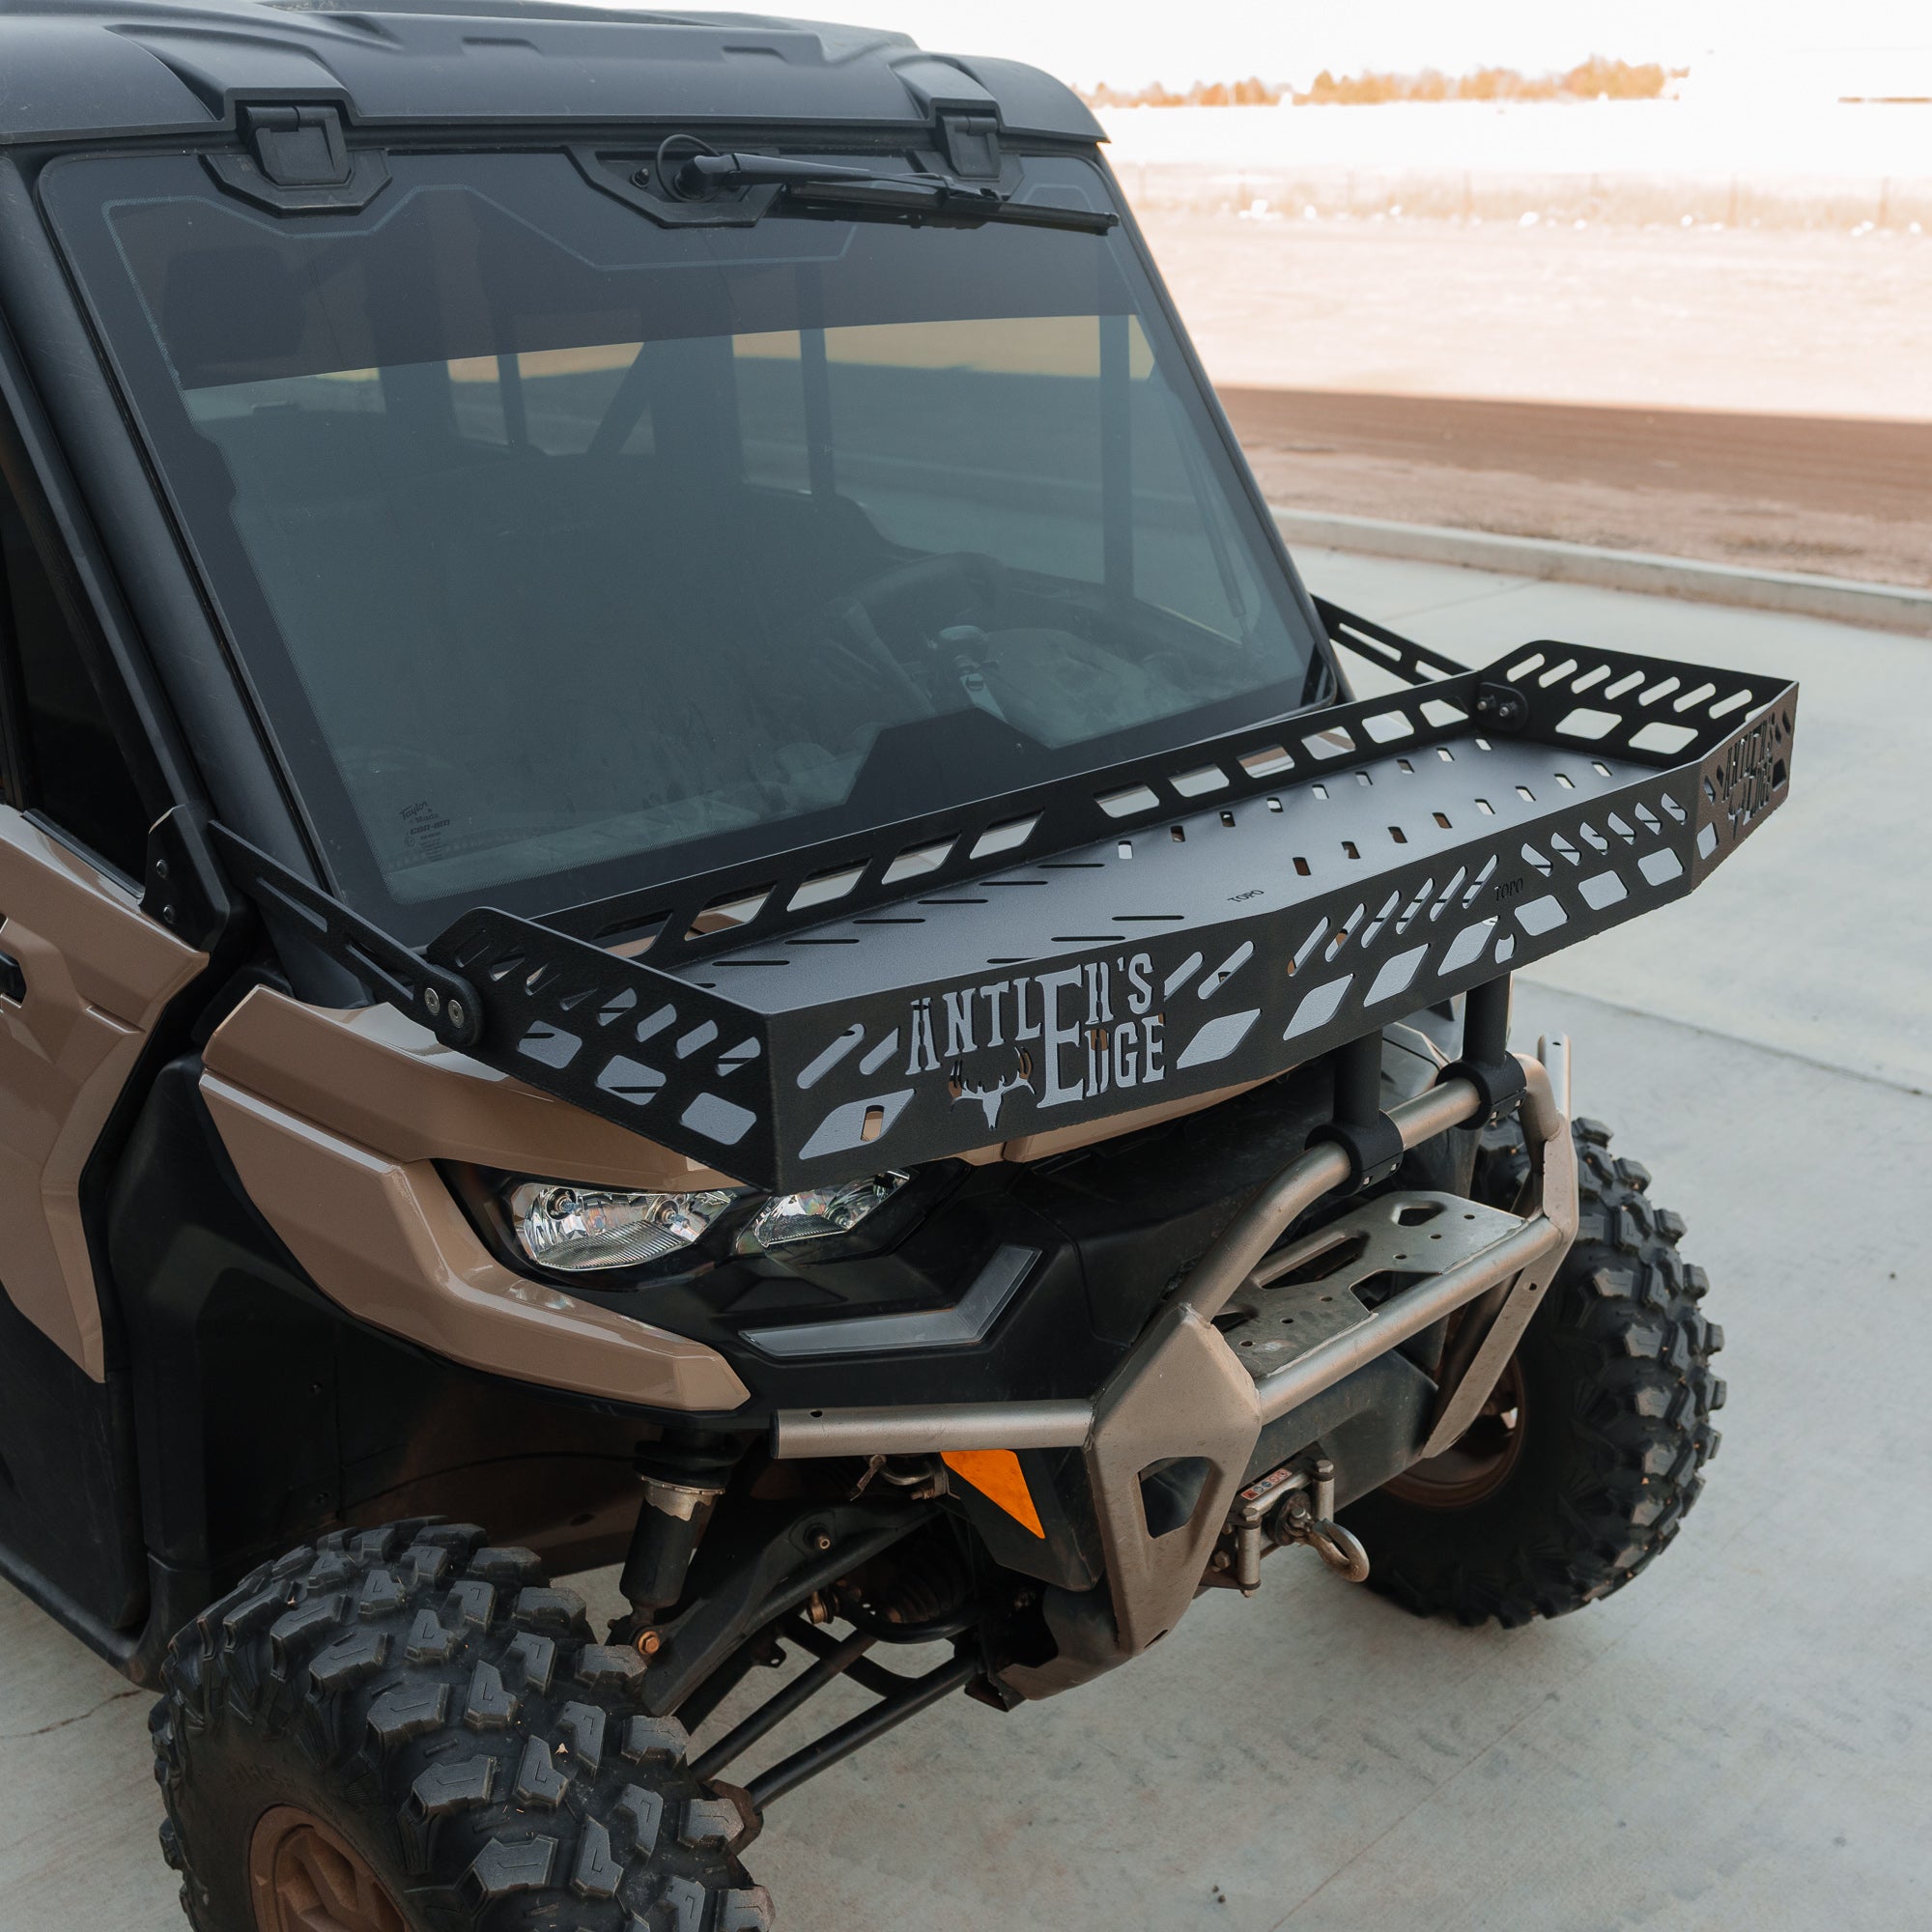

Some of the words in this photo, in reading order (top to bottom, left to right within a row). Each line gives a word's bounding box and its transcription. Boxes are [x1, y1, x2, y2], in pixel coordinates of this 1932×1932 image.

[398, 801, 428, 820] Taylor
[1227, 890, 1264, 903] TOPO
[1494, 877, 1524, 901] TOPO
[905, 952, 1153, 1092] ANTLER'S
[1035, 964, 1165, 1109] EDGE
